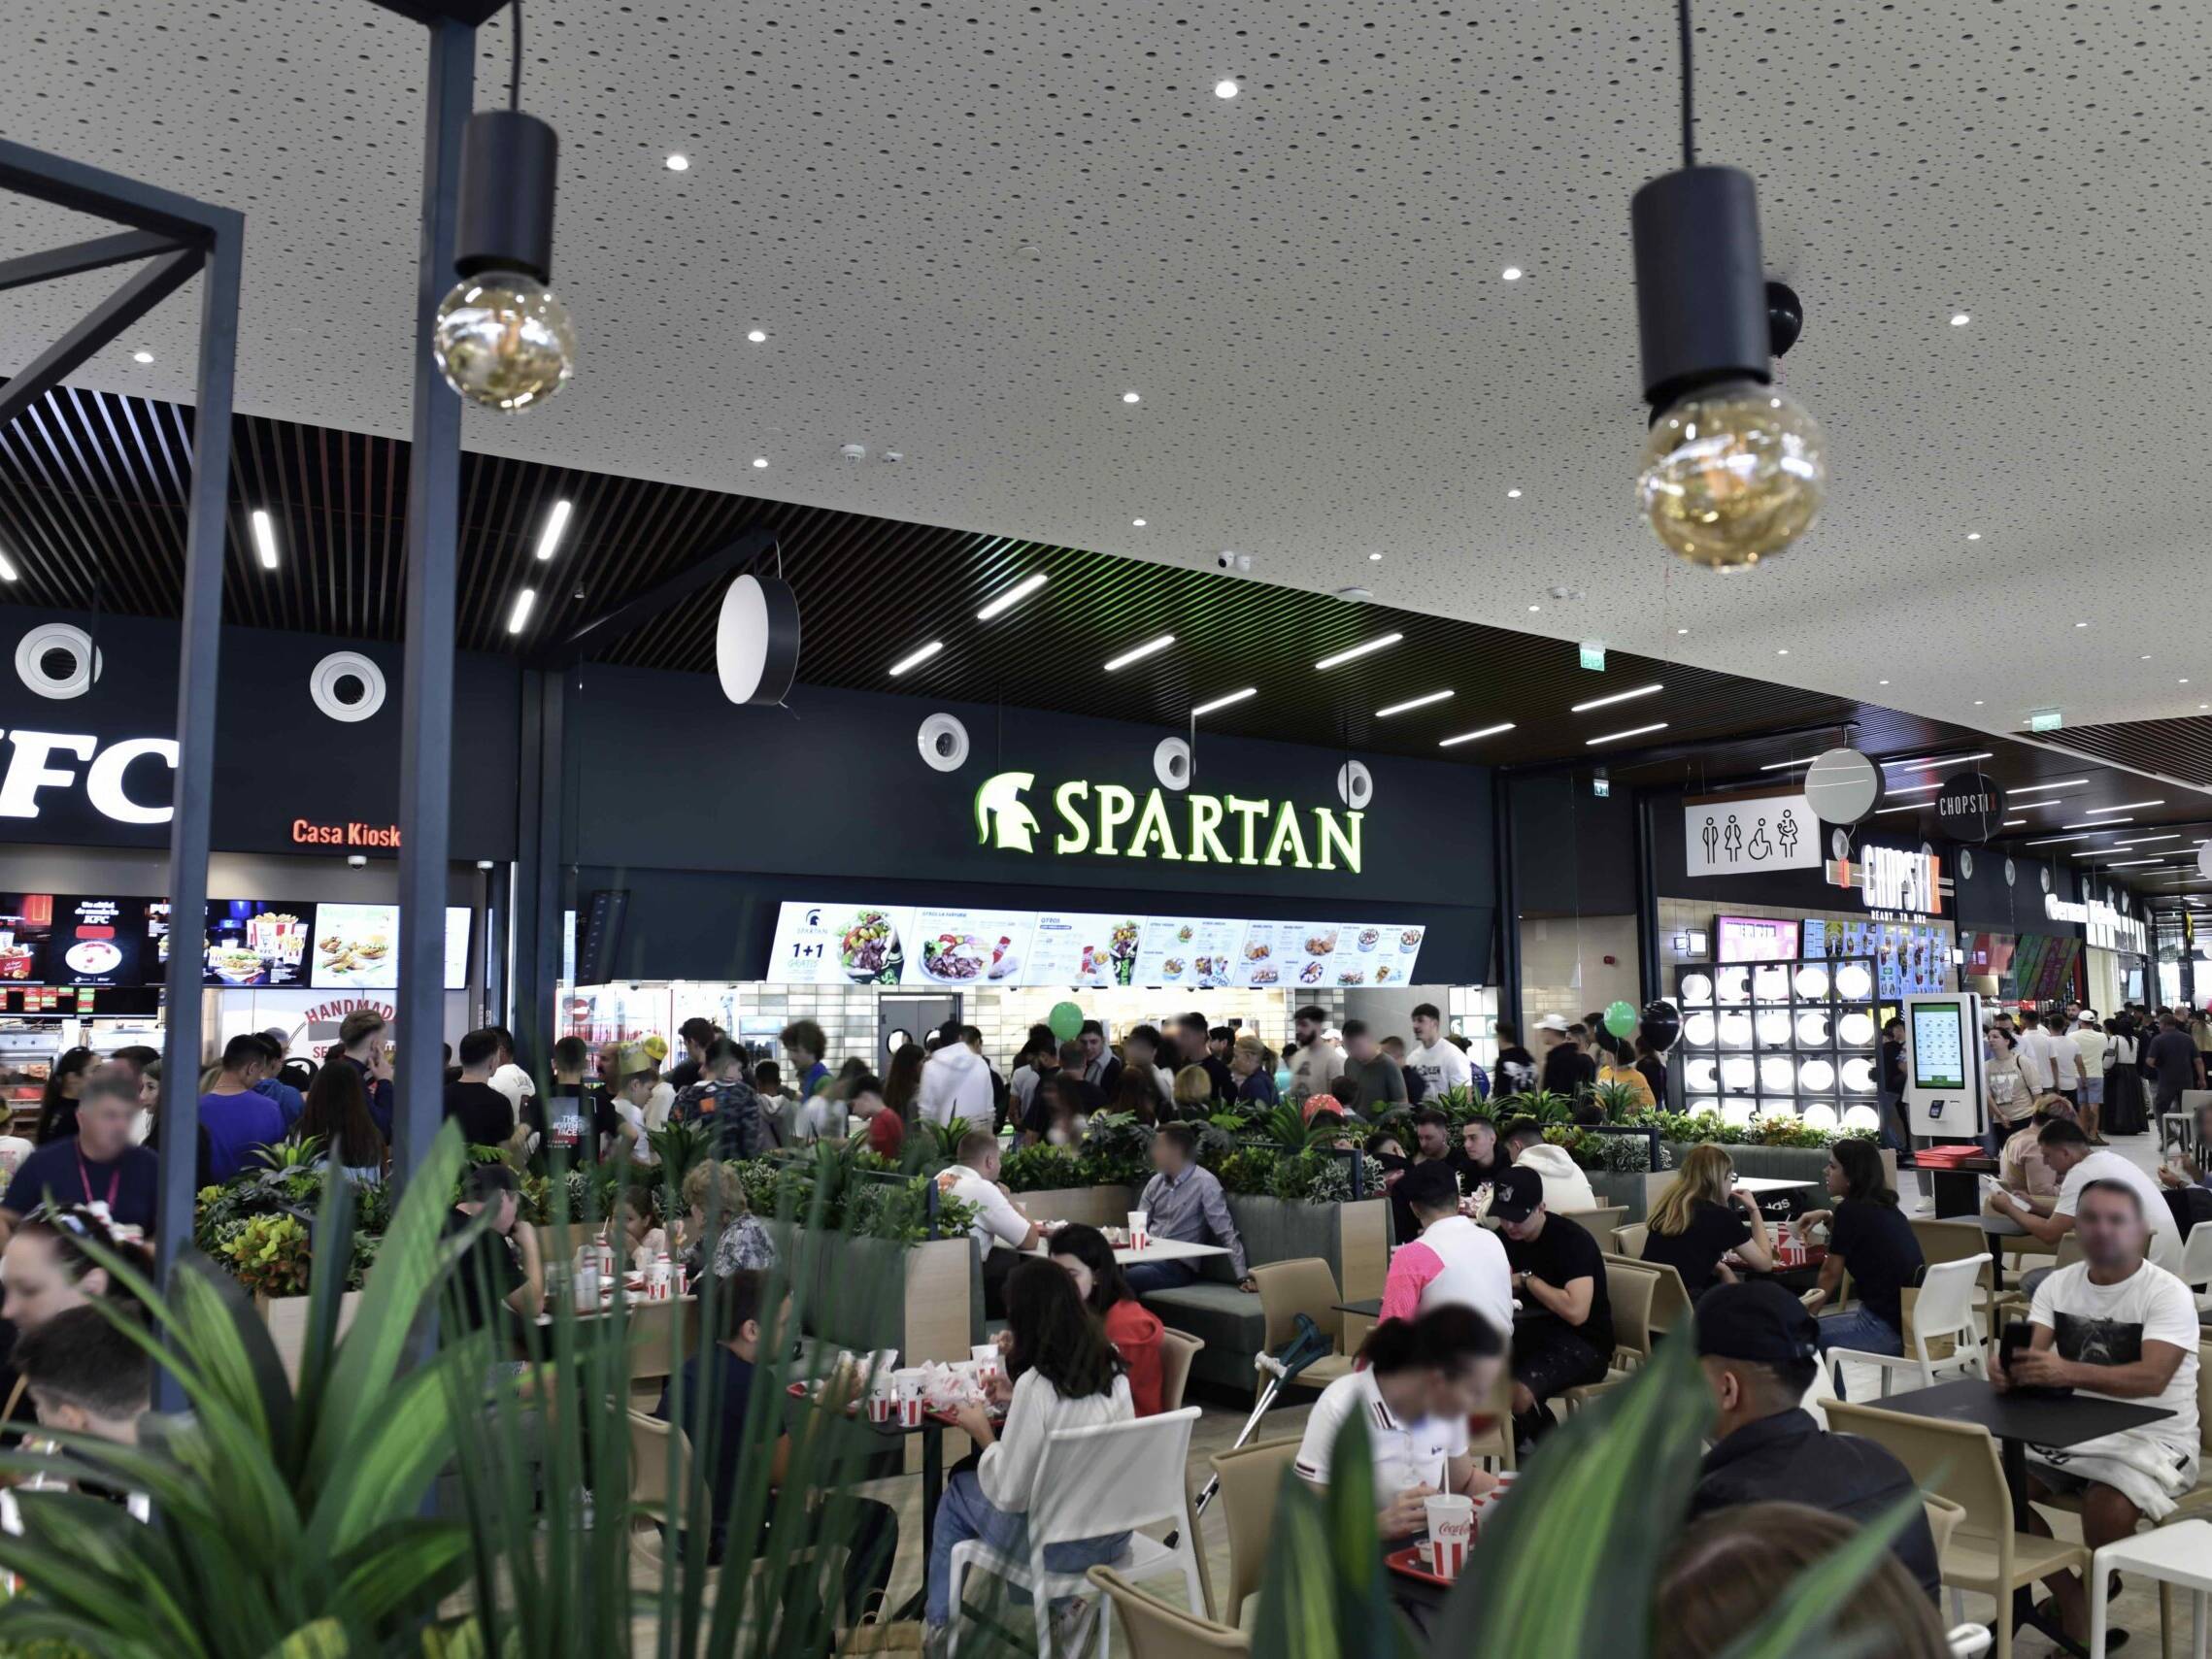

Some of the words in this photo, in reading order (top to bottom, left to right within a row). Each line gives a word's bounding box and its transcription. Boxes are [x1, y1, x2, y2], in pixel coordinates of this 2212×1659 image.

[0, 729, 181, 824] FC
[1939, 792, 1997, 816] CHOPSTIX
[293, 819, 343, 845] Casa
[348, 822, 401, 847] Kiosk
[1053, 780, 1364, 874] SPARTAN
[1870, 910, 1894, 922] READY
[1899, 912, 1908, 923] TO
[792, 943, 824, 959] 1+1
[304, 999, 399, 1025] HANDMAD
